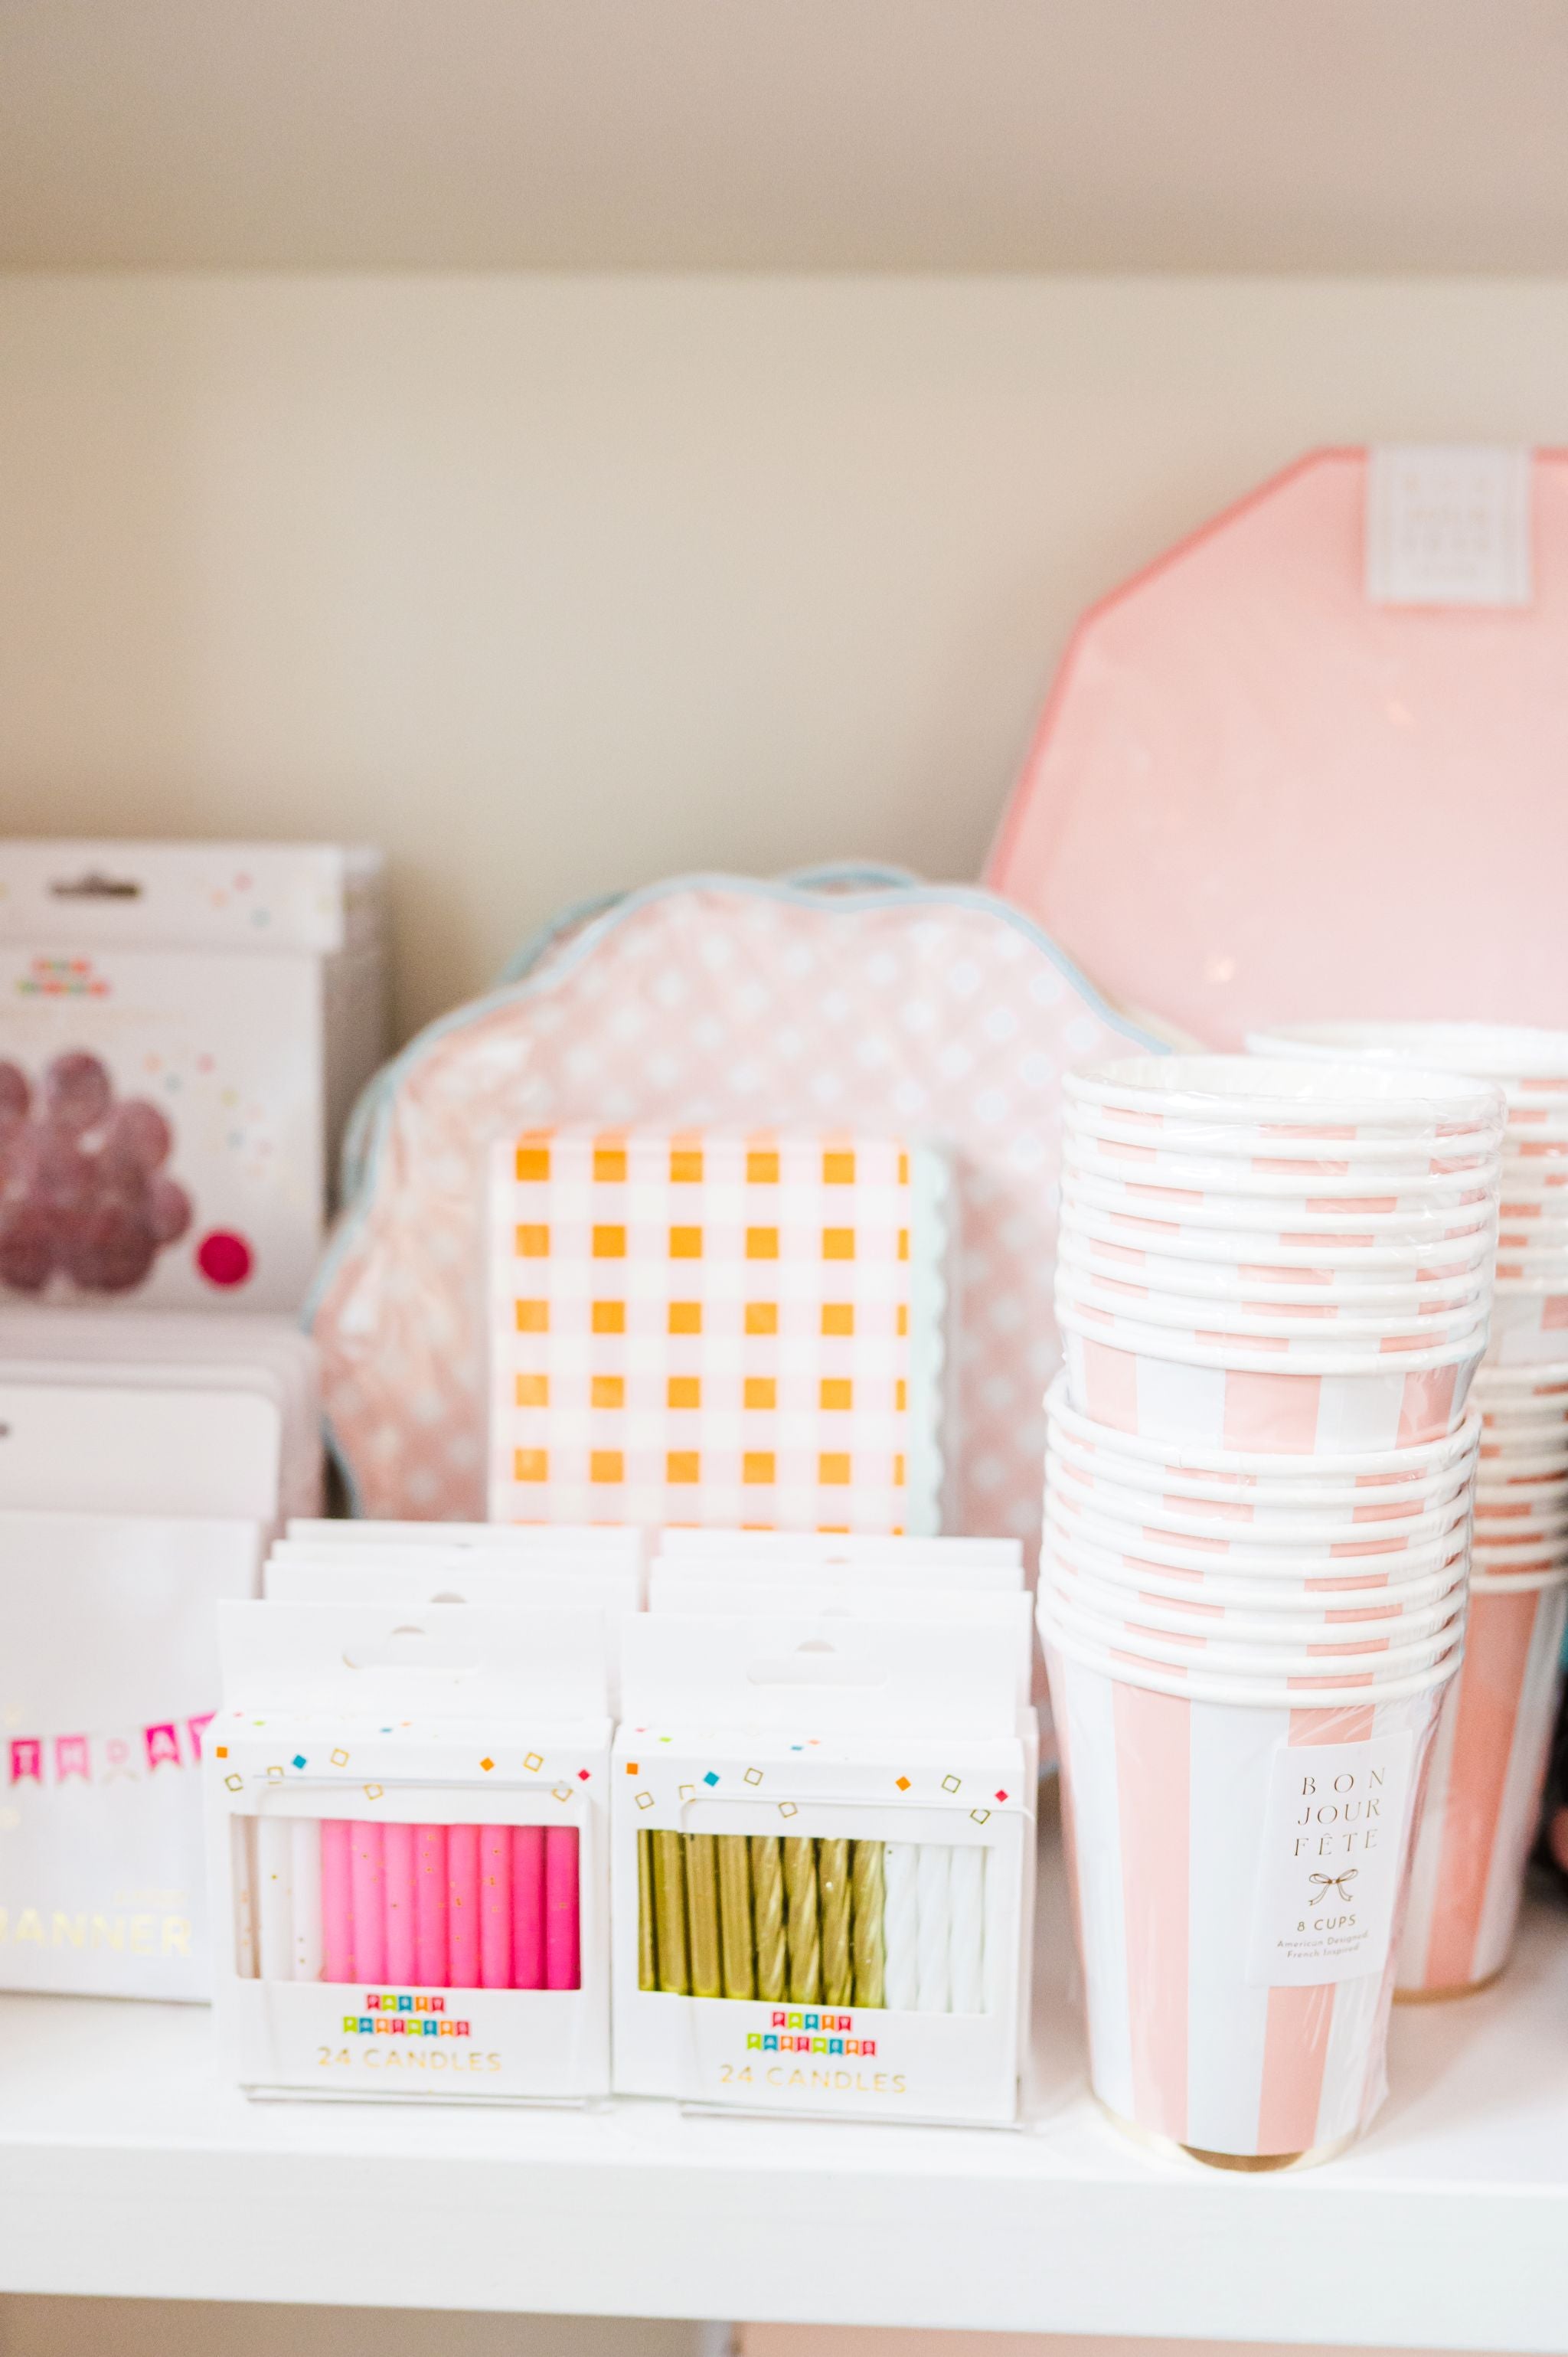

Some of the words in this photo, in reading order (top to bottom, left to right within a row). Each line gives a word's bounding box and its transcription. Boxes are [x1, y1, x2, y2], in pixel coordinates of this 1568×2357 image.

[1302, 1767, 1386, 1795] BON
[1298, 1798, 1380, 1826] JOUR
[1294, 1829, 1378, 1856] FÊTE
[1297, 1921, 1305, 1932] 8
[1314, 1914, 1357, 1930] CUPS
[1277, 1939, 1323, 1948] American
[1328, 1930, 1369, 1946] Designed
[1287, 1949, 1319, 1958] French
[1323, 1943, 1360, 1957] Inspired
[317, 2047, 352, 2067] 24
[364, 2048, 502, 2071] CANDLES
[720, 2064, 753, 2084] 24
[766, 2067, 906, 2094] CANDLES
